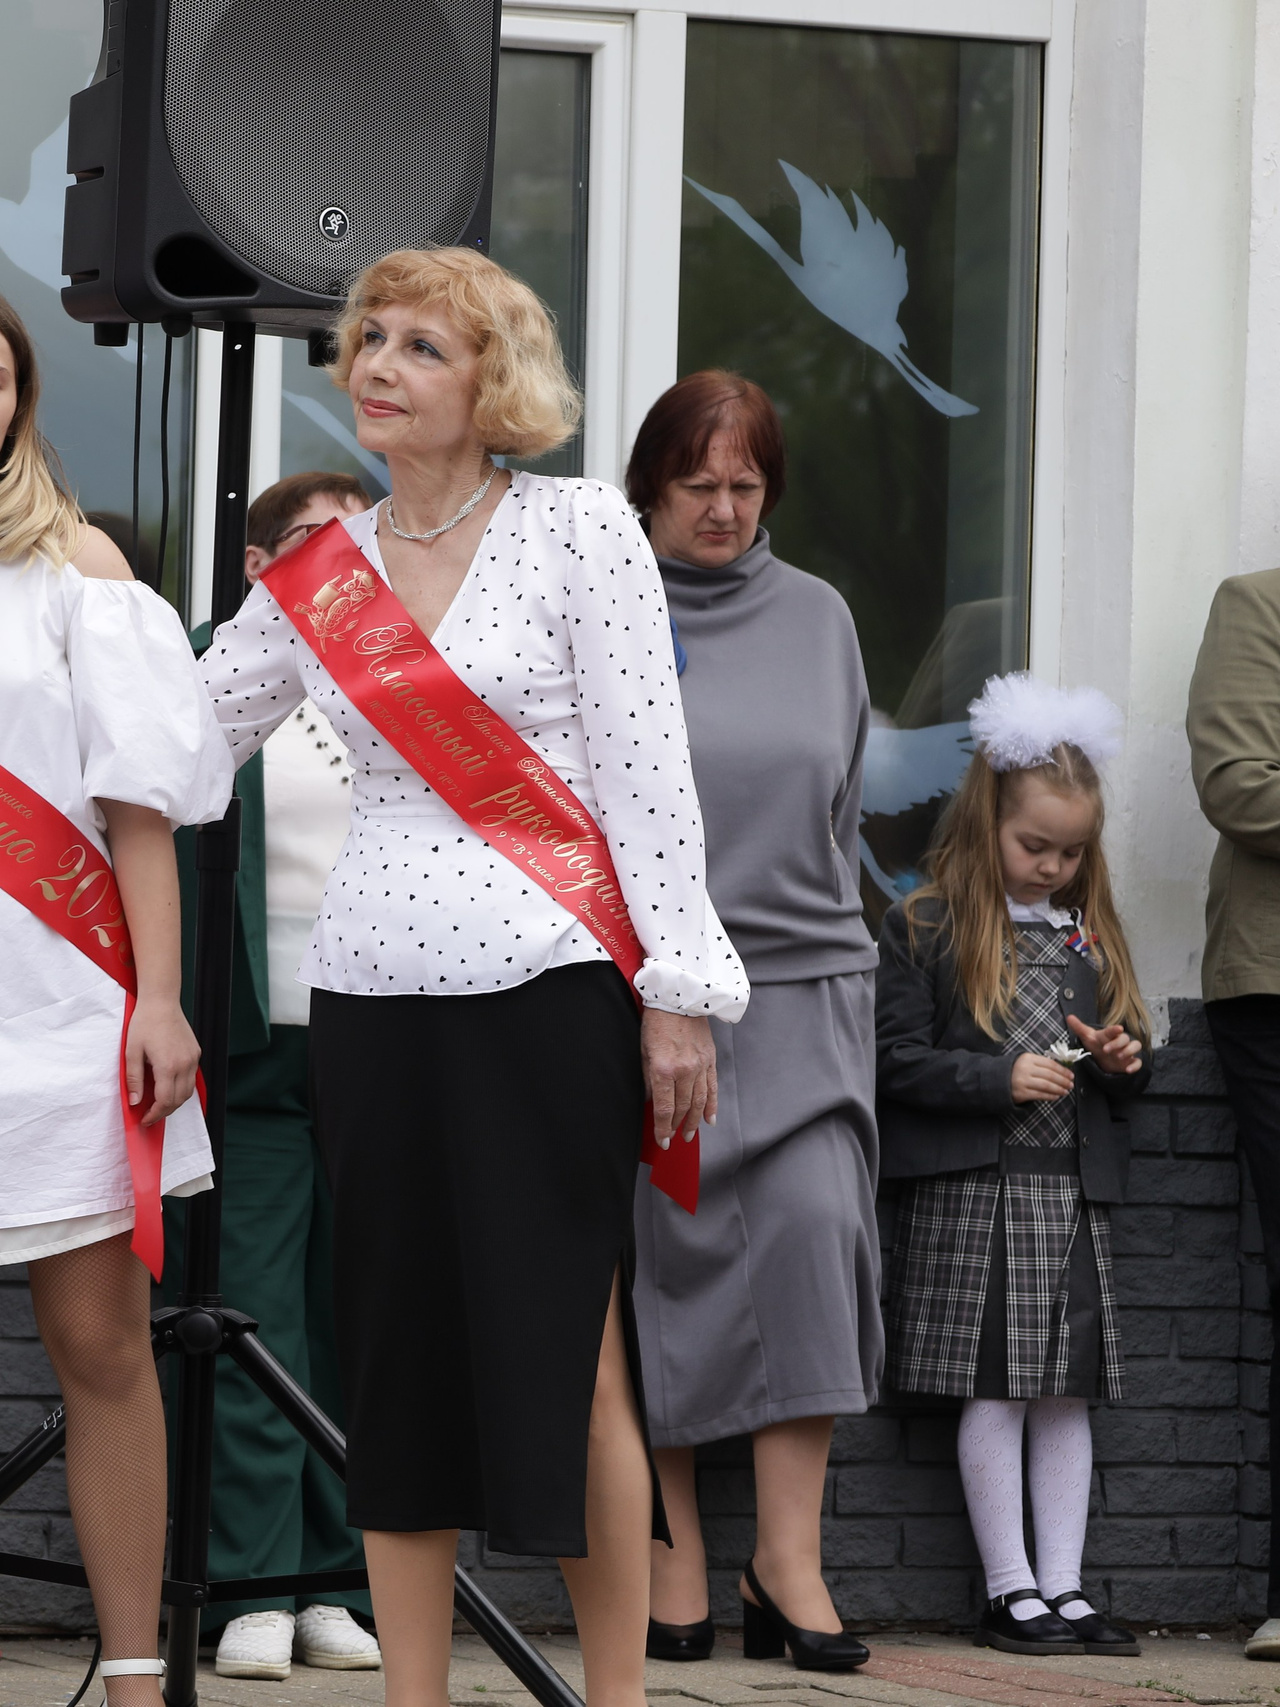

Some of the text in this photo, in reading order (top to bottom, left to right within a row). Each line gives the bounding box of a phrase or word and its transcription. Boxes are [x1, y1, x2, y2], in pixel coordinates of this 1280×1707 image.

[353, 623, 497, 777] Классный
[517, 756, 592, 831] Васильевна
[496, 830, 508, 839] 9
[526, 856, 557, 883] класс
[578, 899, 611, 937] Выпуск
[606, 935, 628, 960] 2025
